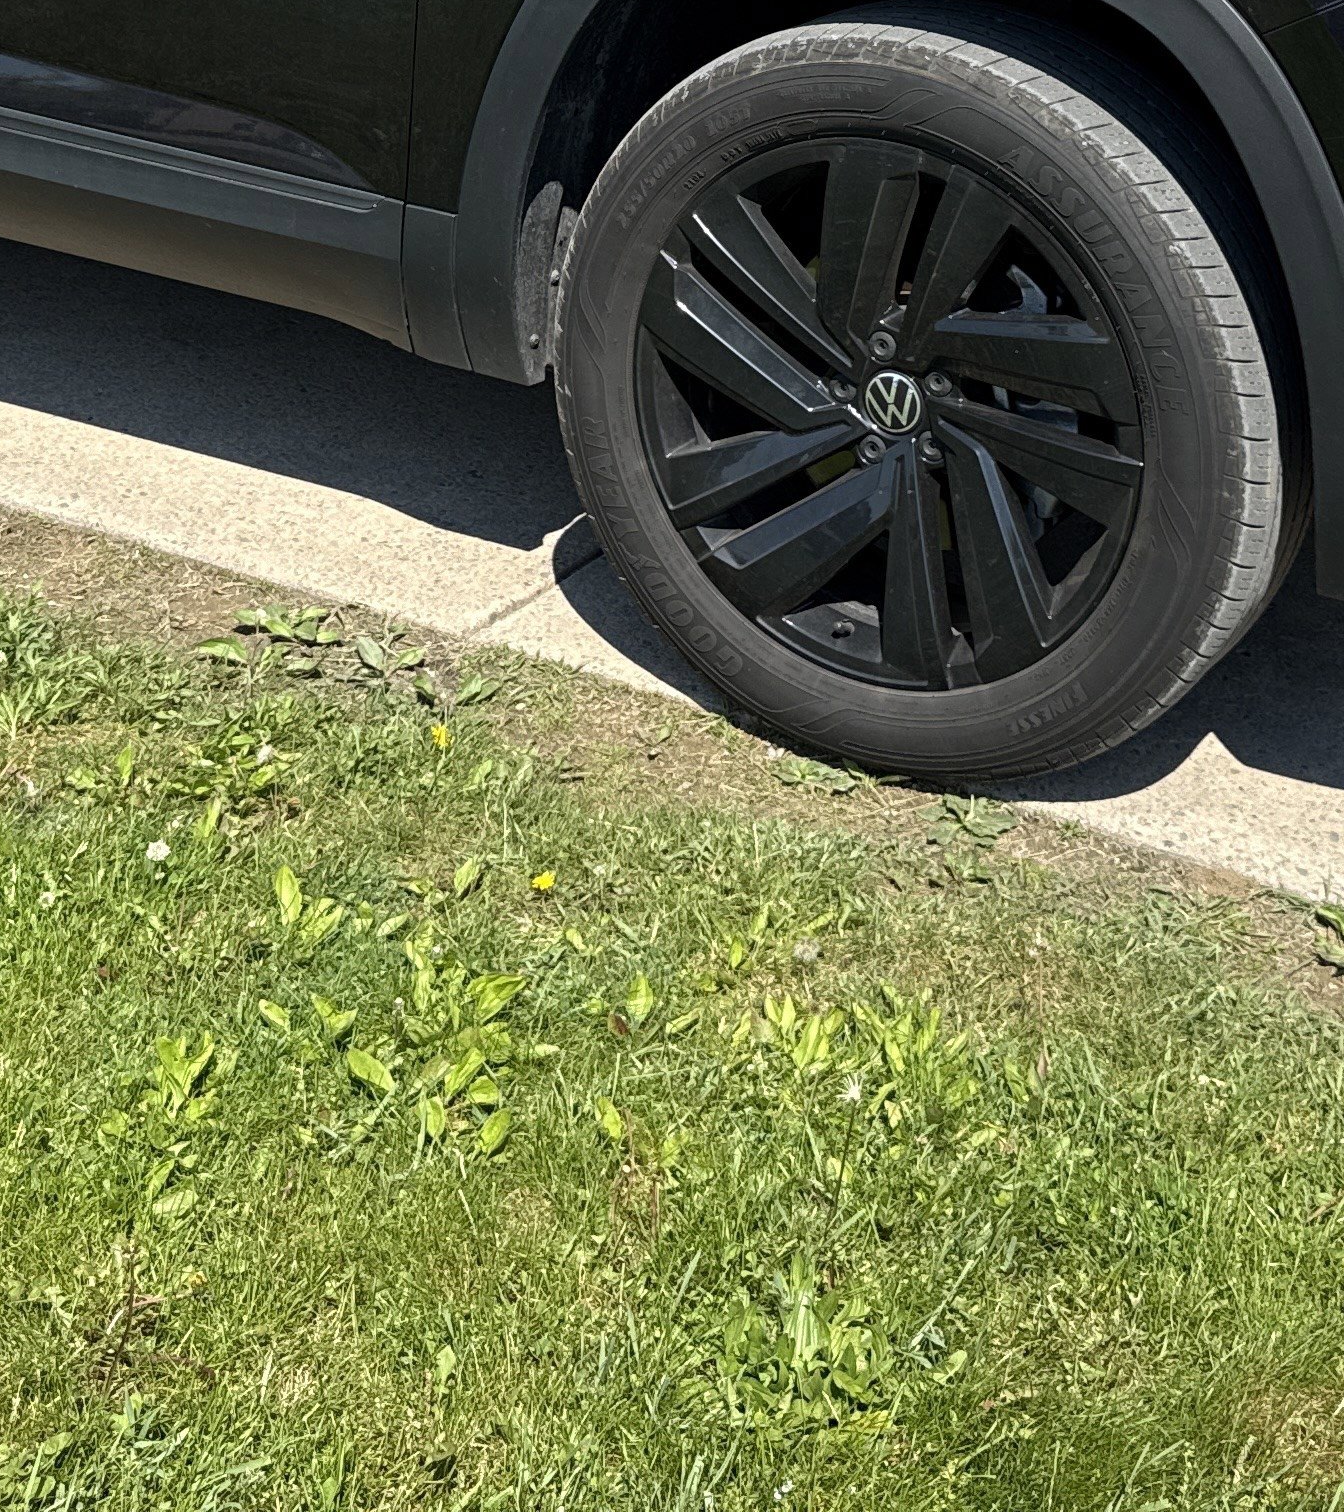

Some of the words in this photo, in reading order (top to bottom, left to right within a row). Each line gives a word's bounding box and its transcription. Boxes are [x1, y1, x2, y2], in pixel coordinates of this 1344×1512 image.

[997, 145, 1189, 416] ASSURANCE
[865, 373, 920, 432] VW
[1006, 680, 1089, 736] FINESSE
